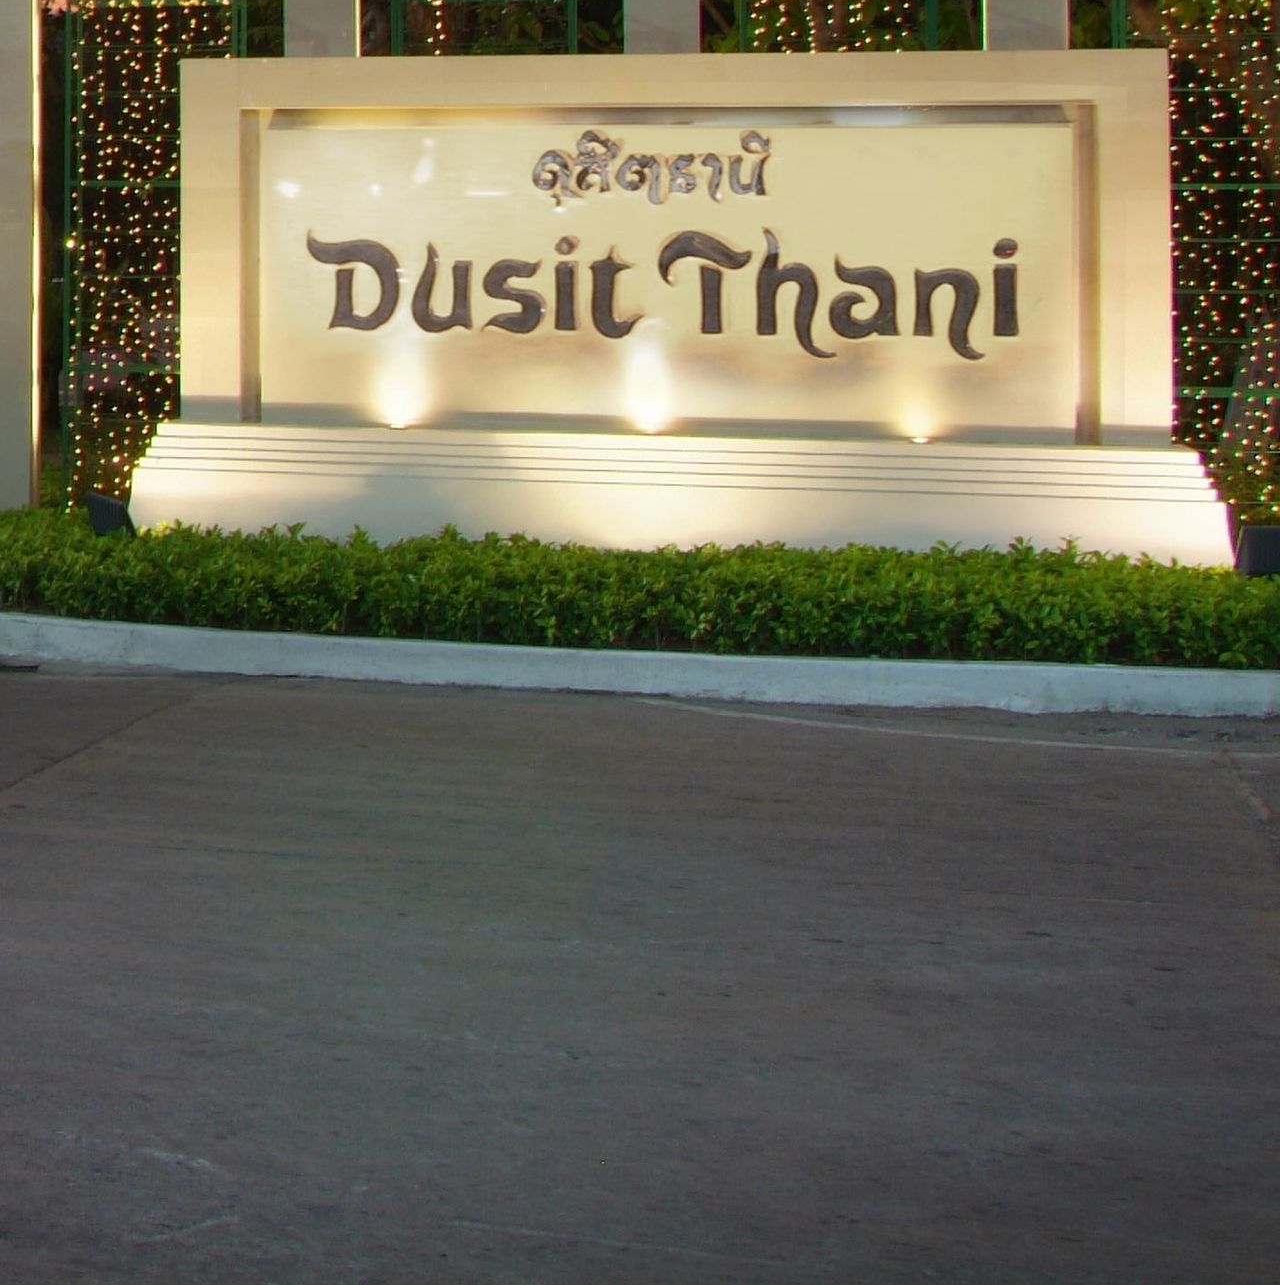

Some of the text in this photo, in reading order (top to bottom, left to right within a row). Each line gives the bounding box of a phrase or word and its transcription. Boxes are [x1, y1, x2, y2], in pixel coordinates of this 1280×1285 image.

[531, 128, 772, 207] ดุสิตธานี
[305, 227, 1022, 360] Dusit Thani
